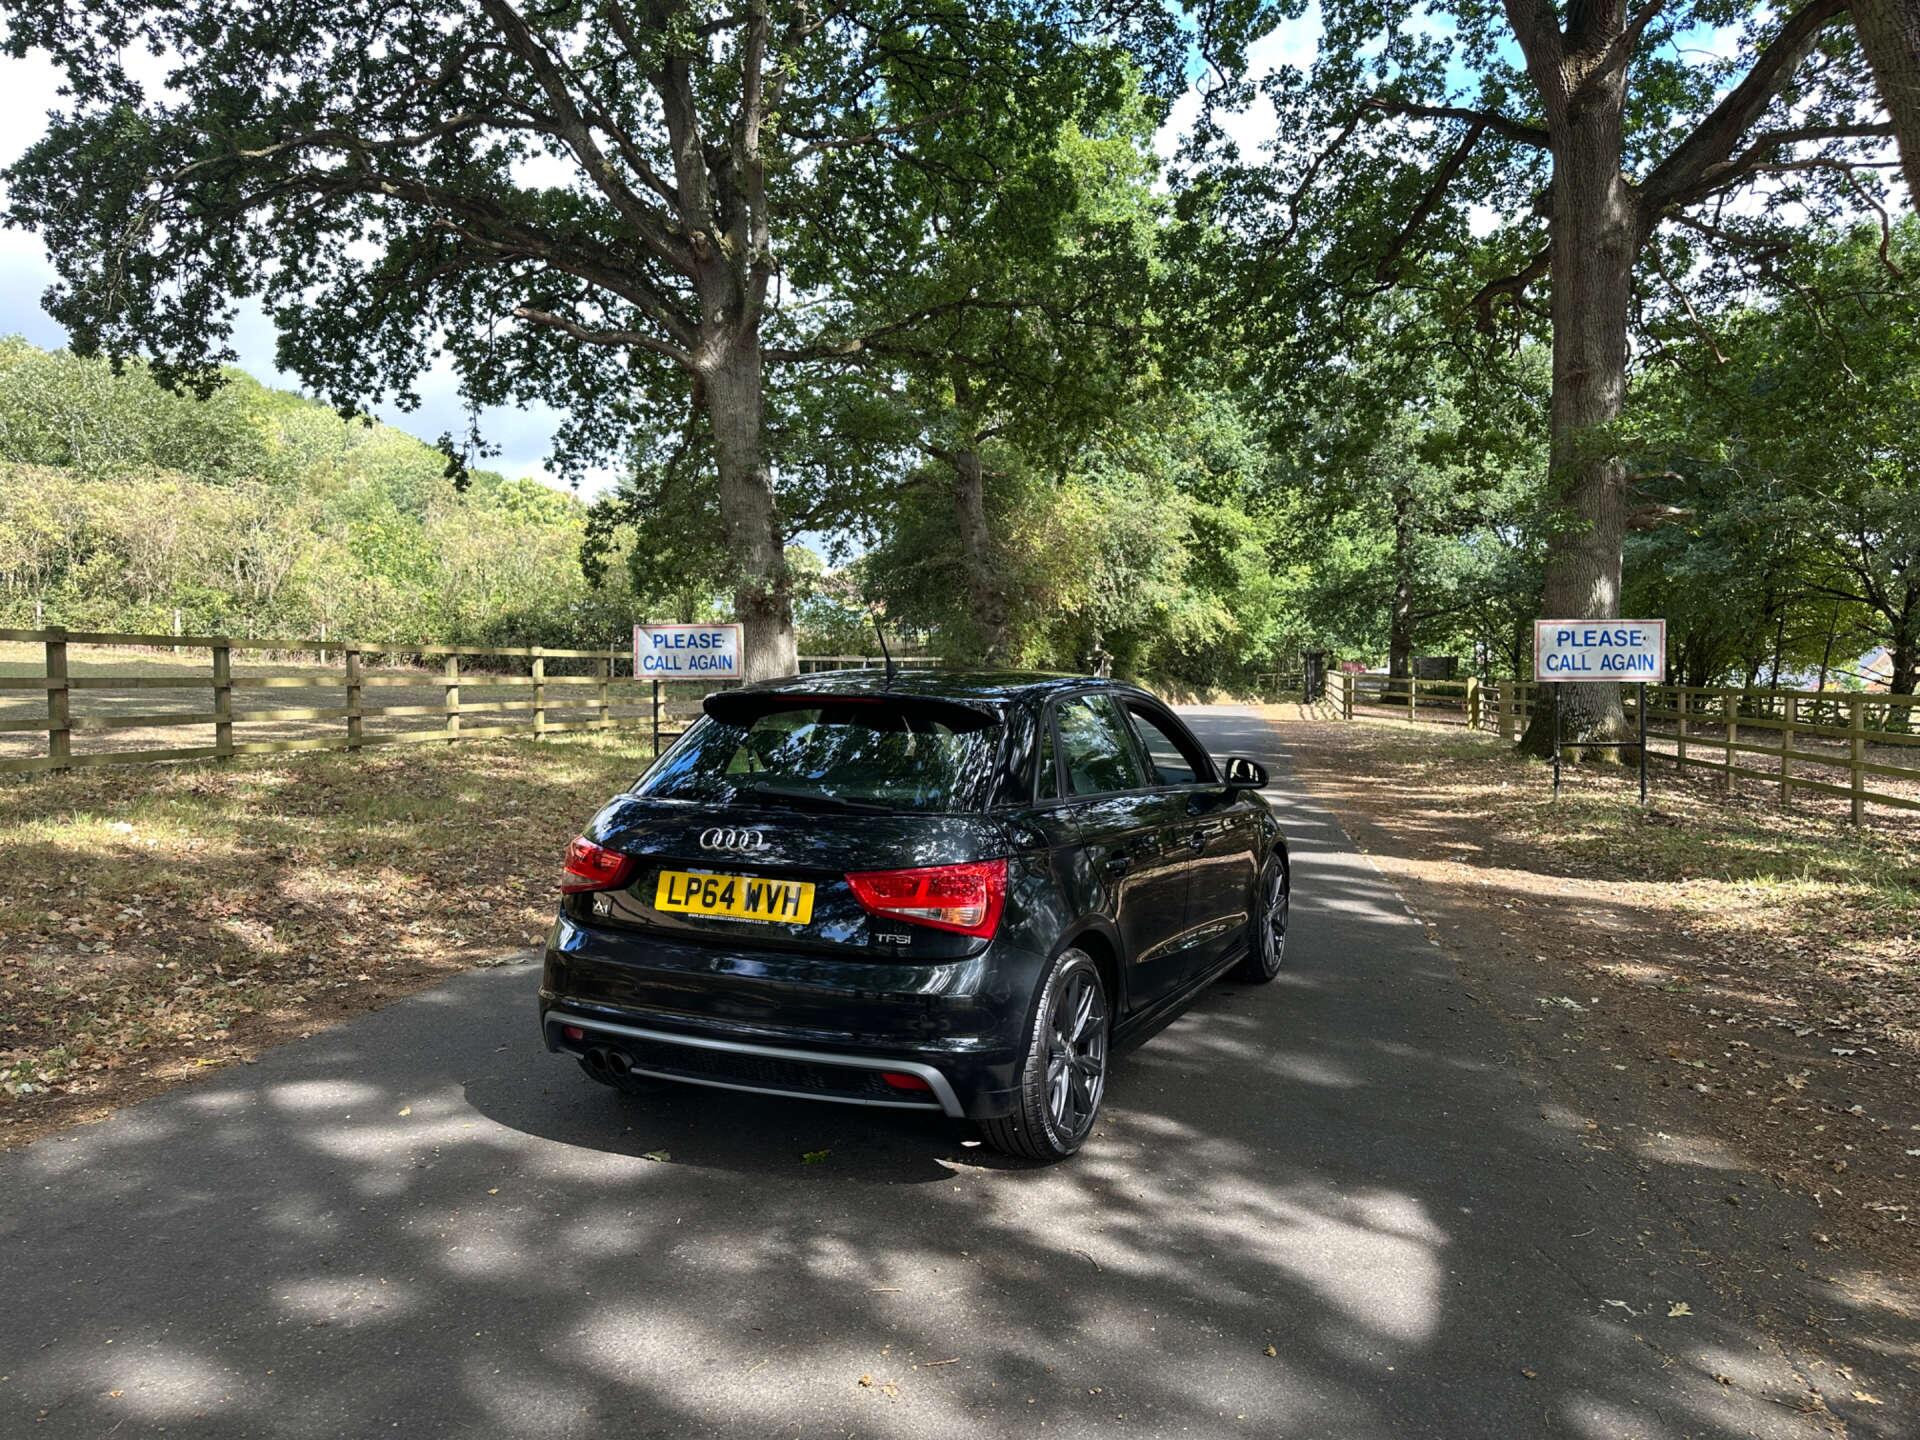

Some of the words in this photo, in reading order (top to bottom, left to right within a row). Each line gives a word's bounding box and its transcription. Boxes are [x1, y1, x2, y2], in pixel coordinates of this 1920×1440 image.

[653, 633, 722, 649] PLEASE
[1557, 630, 1642, 647] PLEASE
[643, 655, 682, 671] CALL
[689, 655, 732, 670] AGAIN
[1546, 654, 1591, 671] CALL
[1600, 654, 1654, 671] AGAIN
[667, 876, 735, 910] LP64
[744, 881, 802, 917] WVH
[593, 900, 608, 914] A1
[875, 933, 911, 944] TFSI
